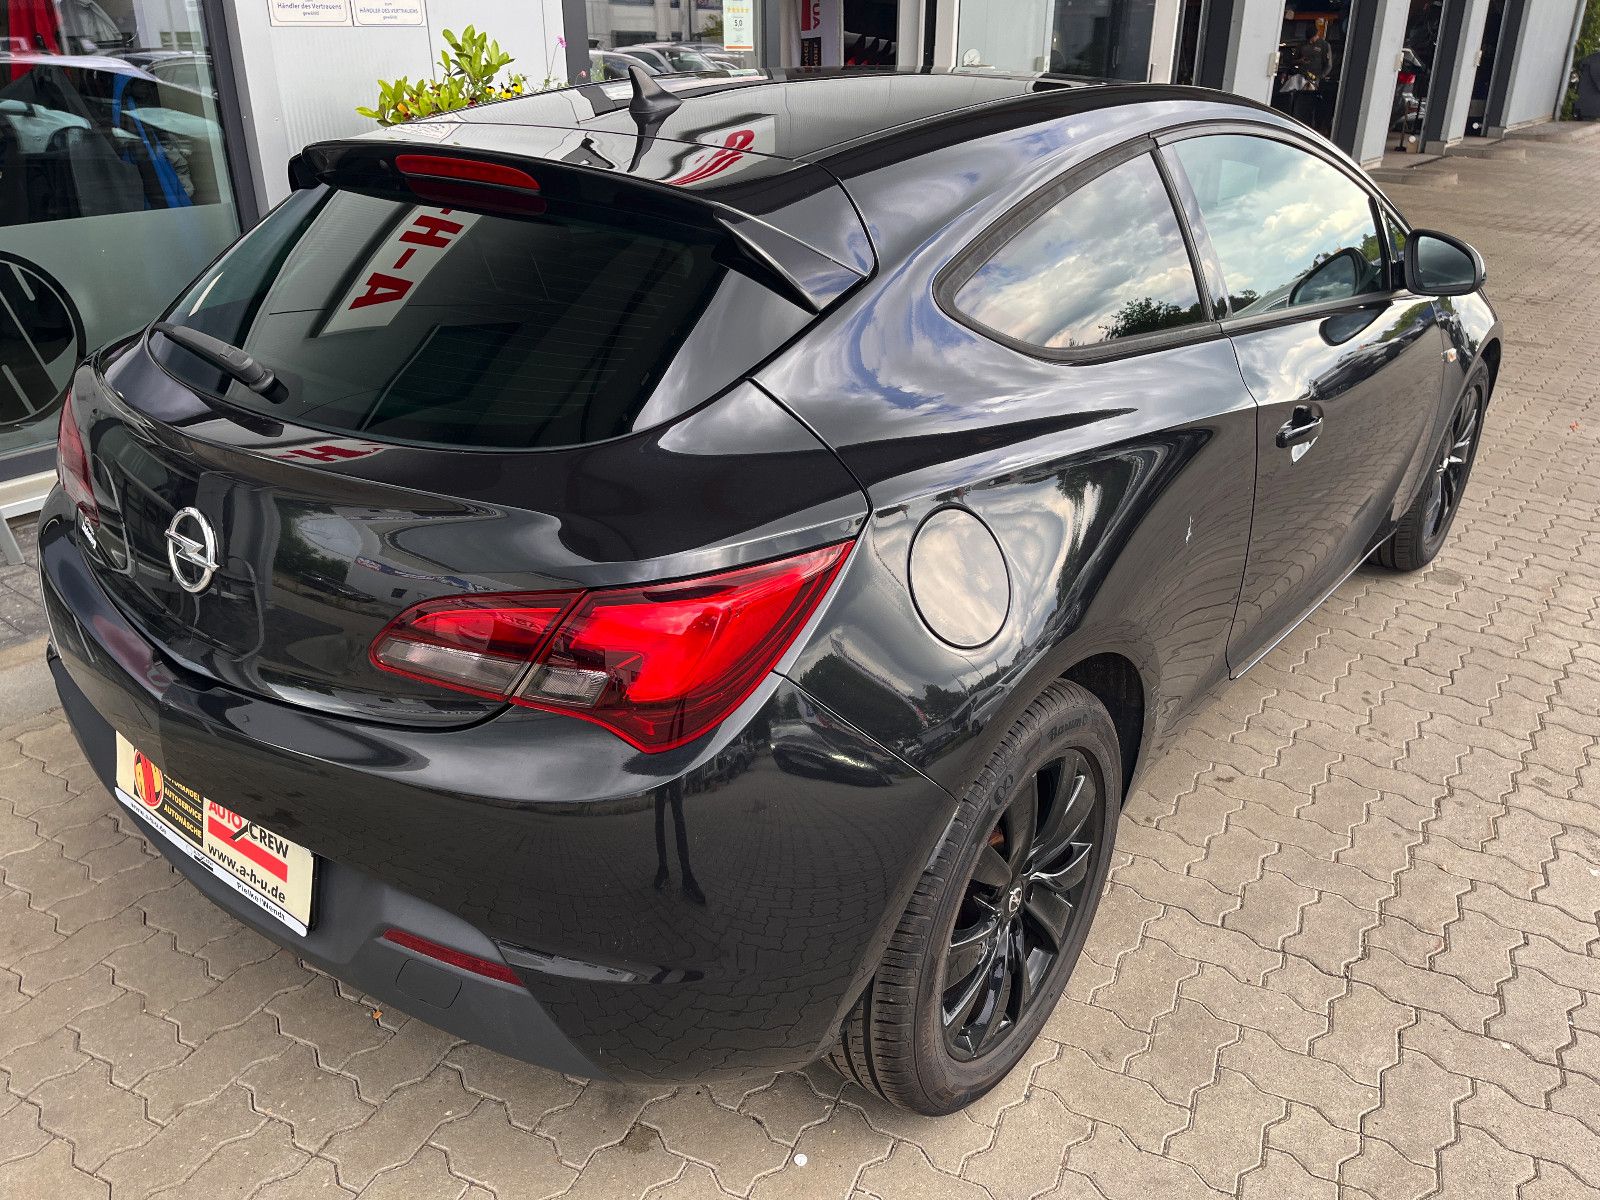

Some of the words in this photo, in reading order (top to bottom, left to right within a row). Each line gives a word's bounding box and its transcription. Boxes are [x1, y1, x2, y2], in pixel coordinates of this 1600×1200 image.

[208, 801, 243, 830] AUTO
[248, 822, 289, 859] CREW
[208, 843, 286, 904] www.a-h-u.de
